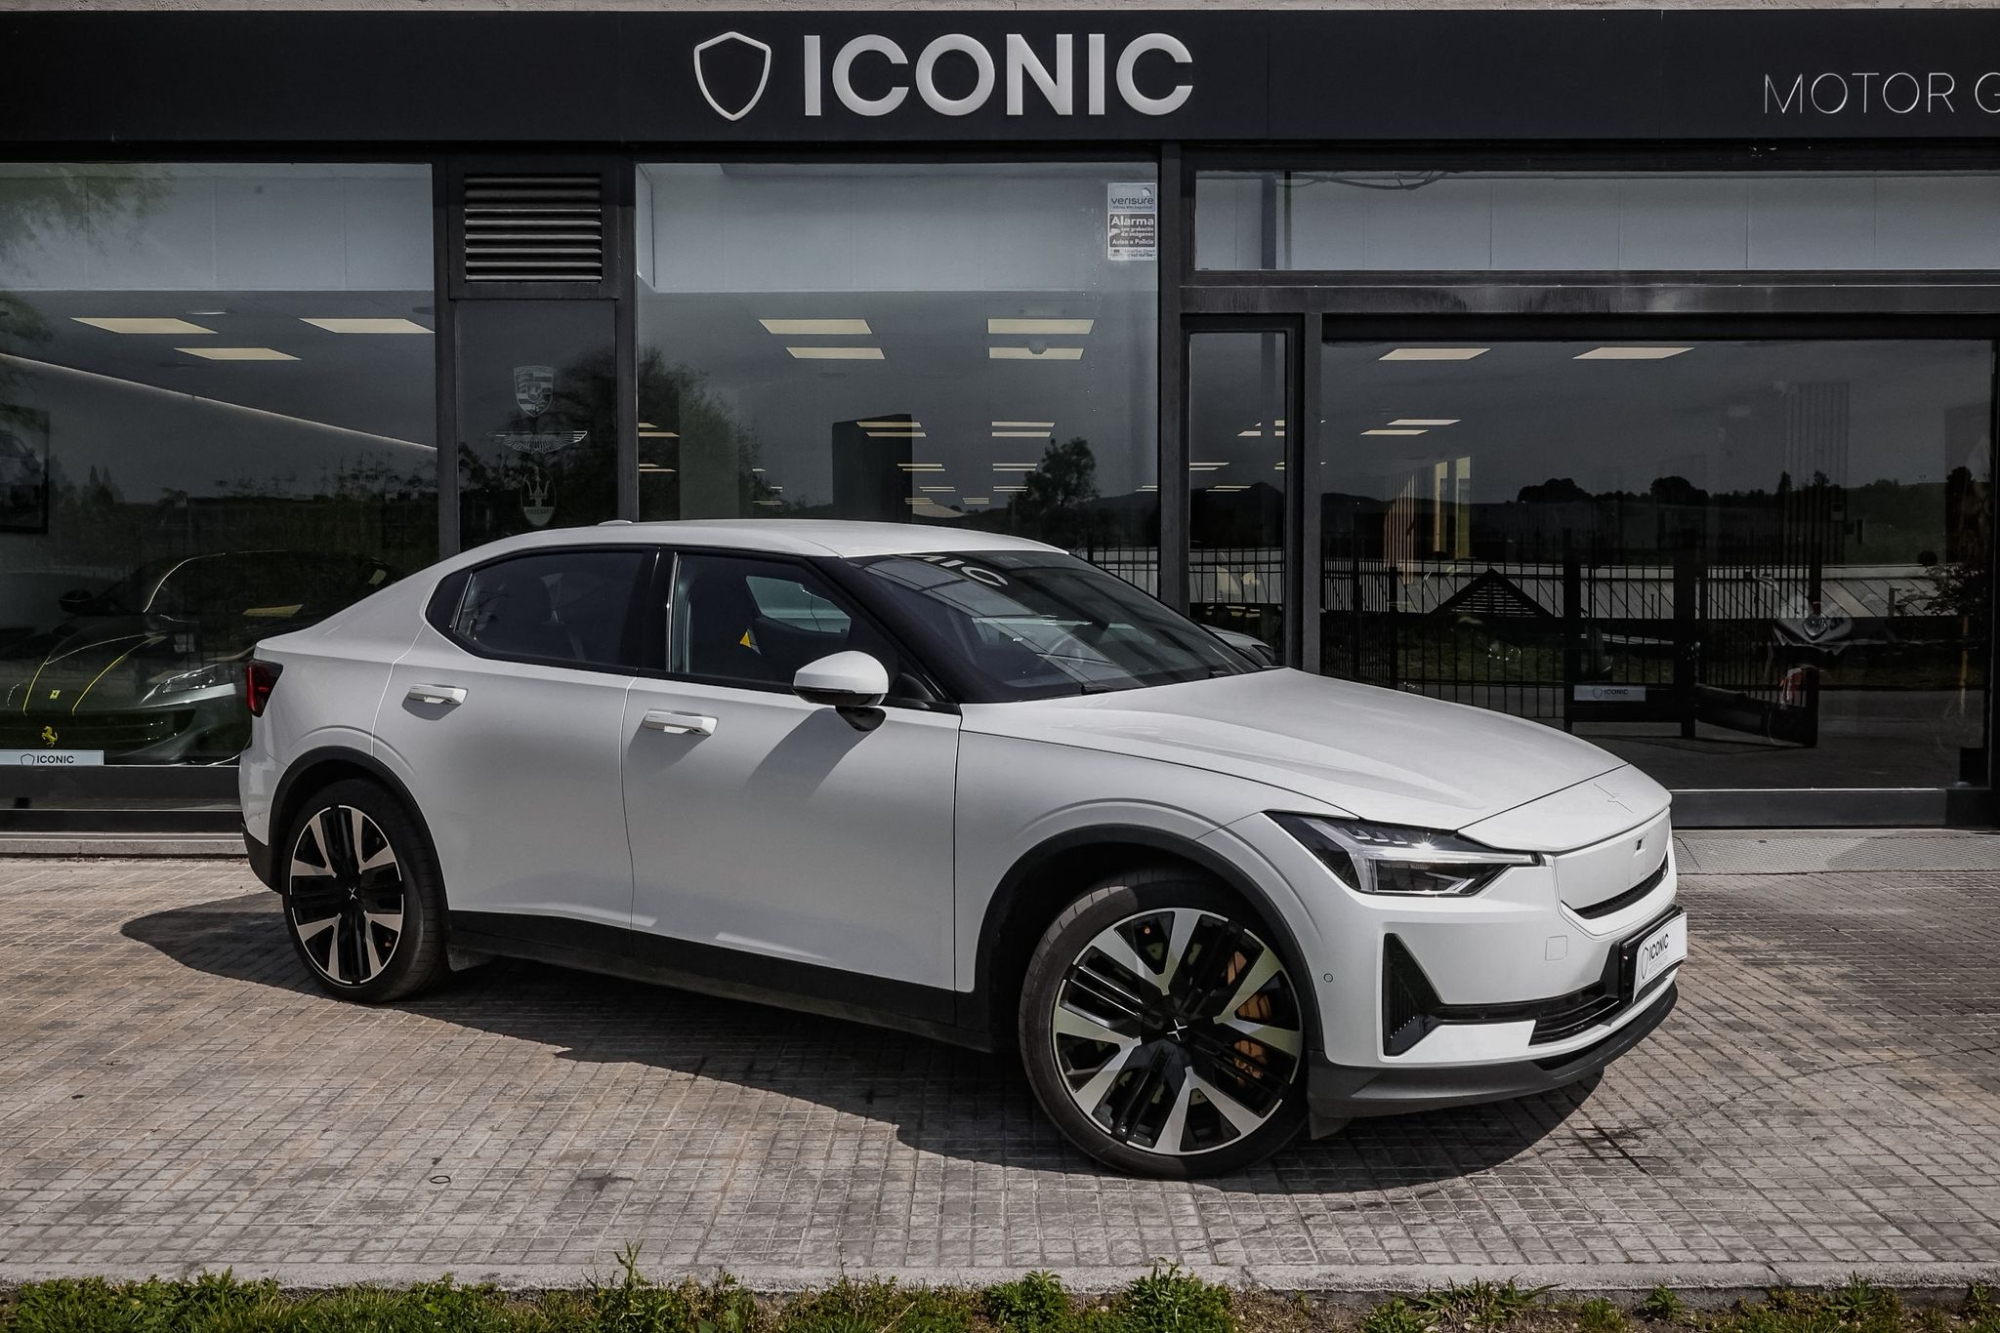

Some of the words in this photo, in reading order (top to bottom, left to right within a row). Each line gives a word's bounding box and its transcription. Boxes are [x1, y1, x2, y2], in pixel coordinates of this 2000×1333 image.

[804, 33, 1193, 116] ICONIC
[1764, 72, 1955, 114] MOTOR
[1111, 197, 1154, 205] verisure
[1111, 215, 1154, 226] Alarma
[37, 755, 74, 764] ICONIC
[1648, 933, 1669, 961] ICONIC
